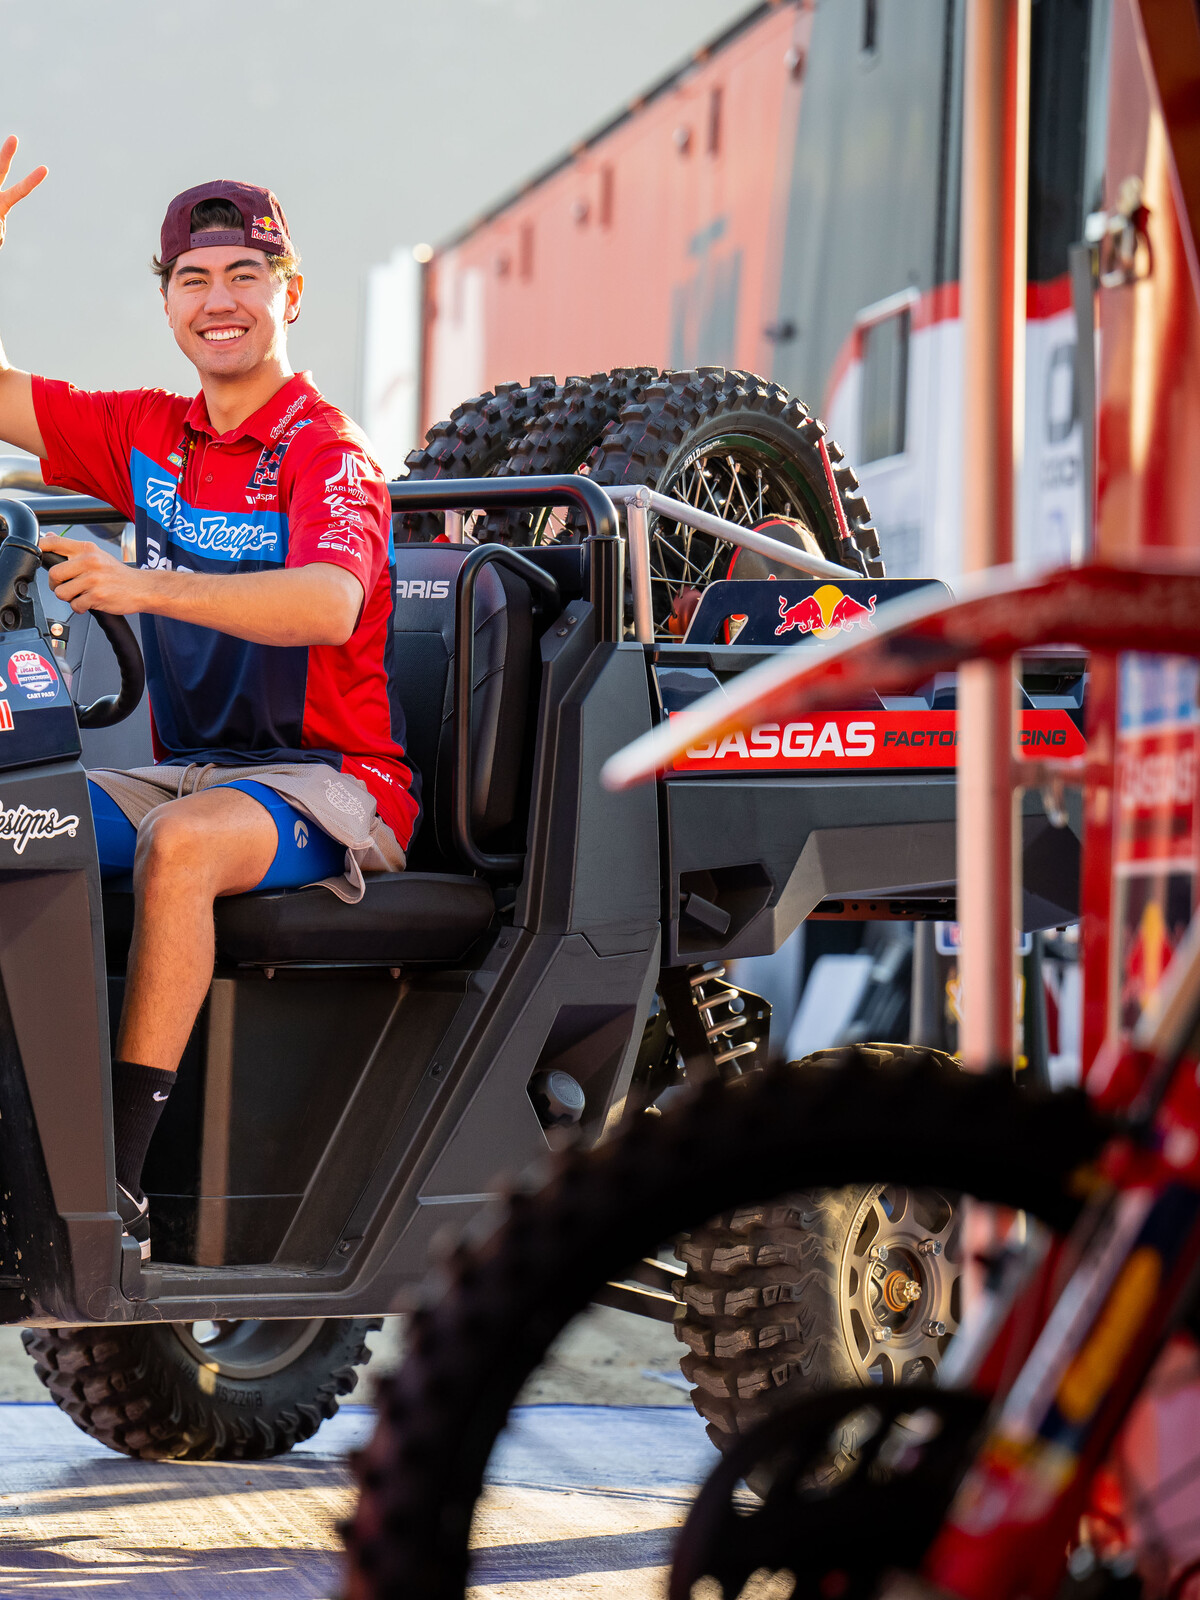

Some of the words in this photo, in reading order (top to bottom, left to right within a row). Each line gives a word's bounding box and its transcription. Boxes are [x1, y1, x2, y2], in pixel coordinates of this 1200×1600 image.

[251, 228, 267, 241] Red
[267, 231, 281, 244] Bull
[325, 485, 346, 493] ATARI
[317, 541, 362, 562] SENA
[396, 580, 450, 598] ARIS
[14, 653, 37, 662] 2022
[883, 730, 961, 747] FACTO
